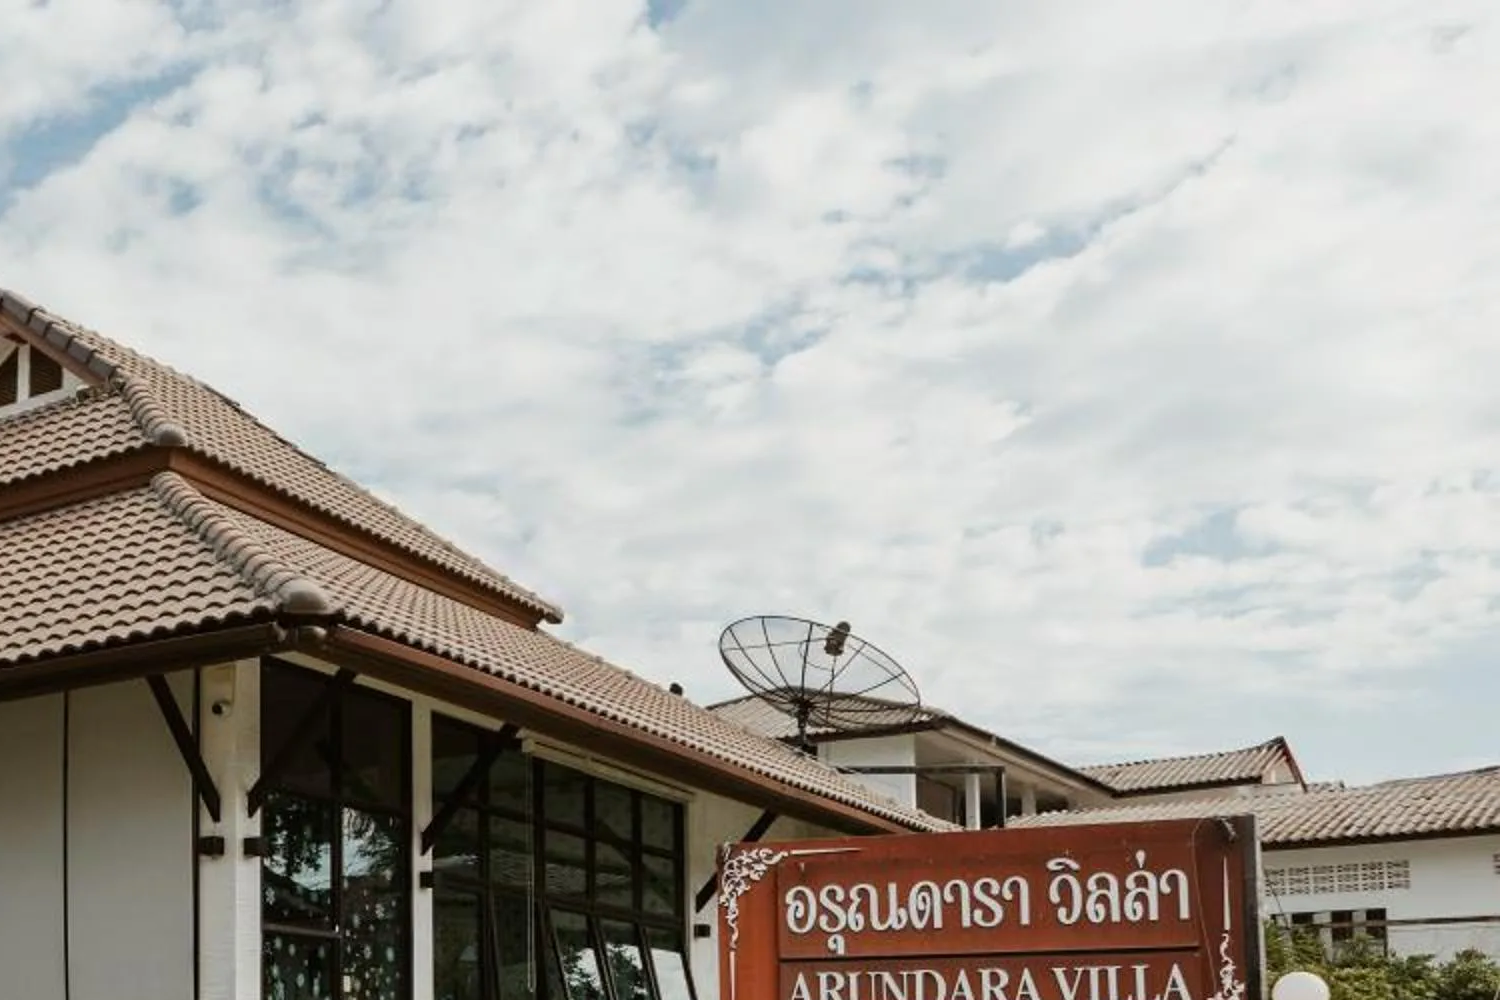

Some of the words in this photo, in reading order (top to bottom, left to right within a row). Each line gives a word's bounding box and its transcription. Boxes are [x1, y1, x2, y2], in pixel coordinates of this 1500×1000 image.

[785, 875, 1030, 955] อรุณดารา
[1047, 849, 1190, 925] วิลล่า
